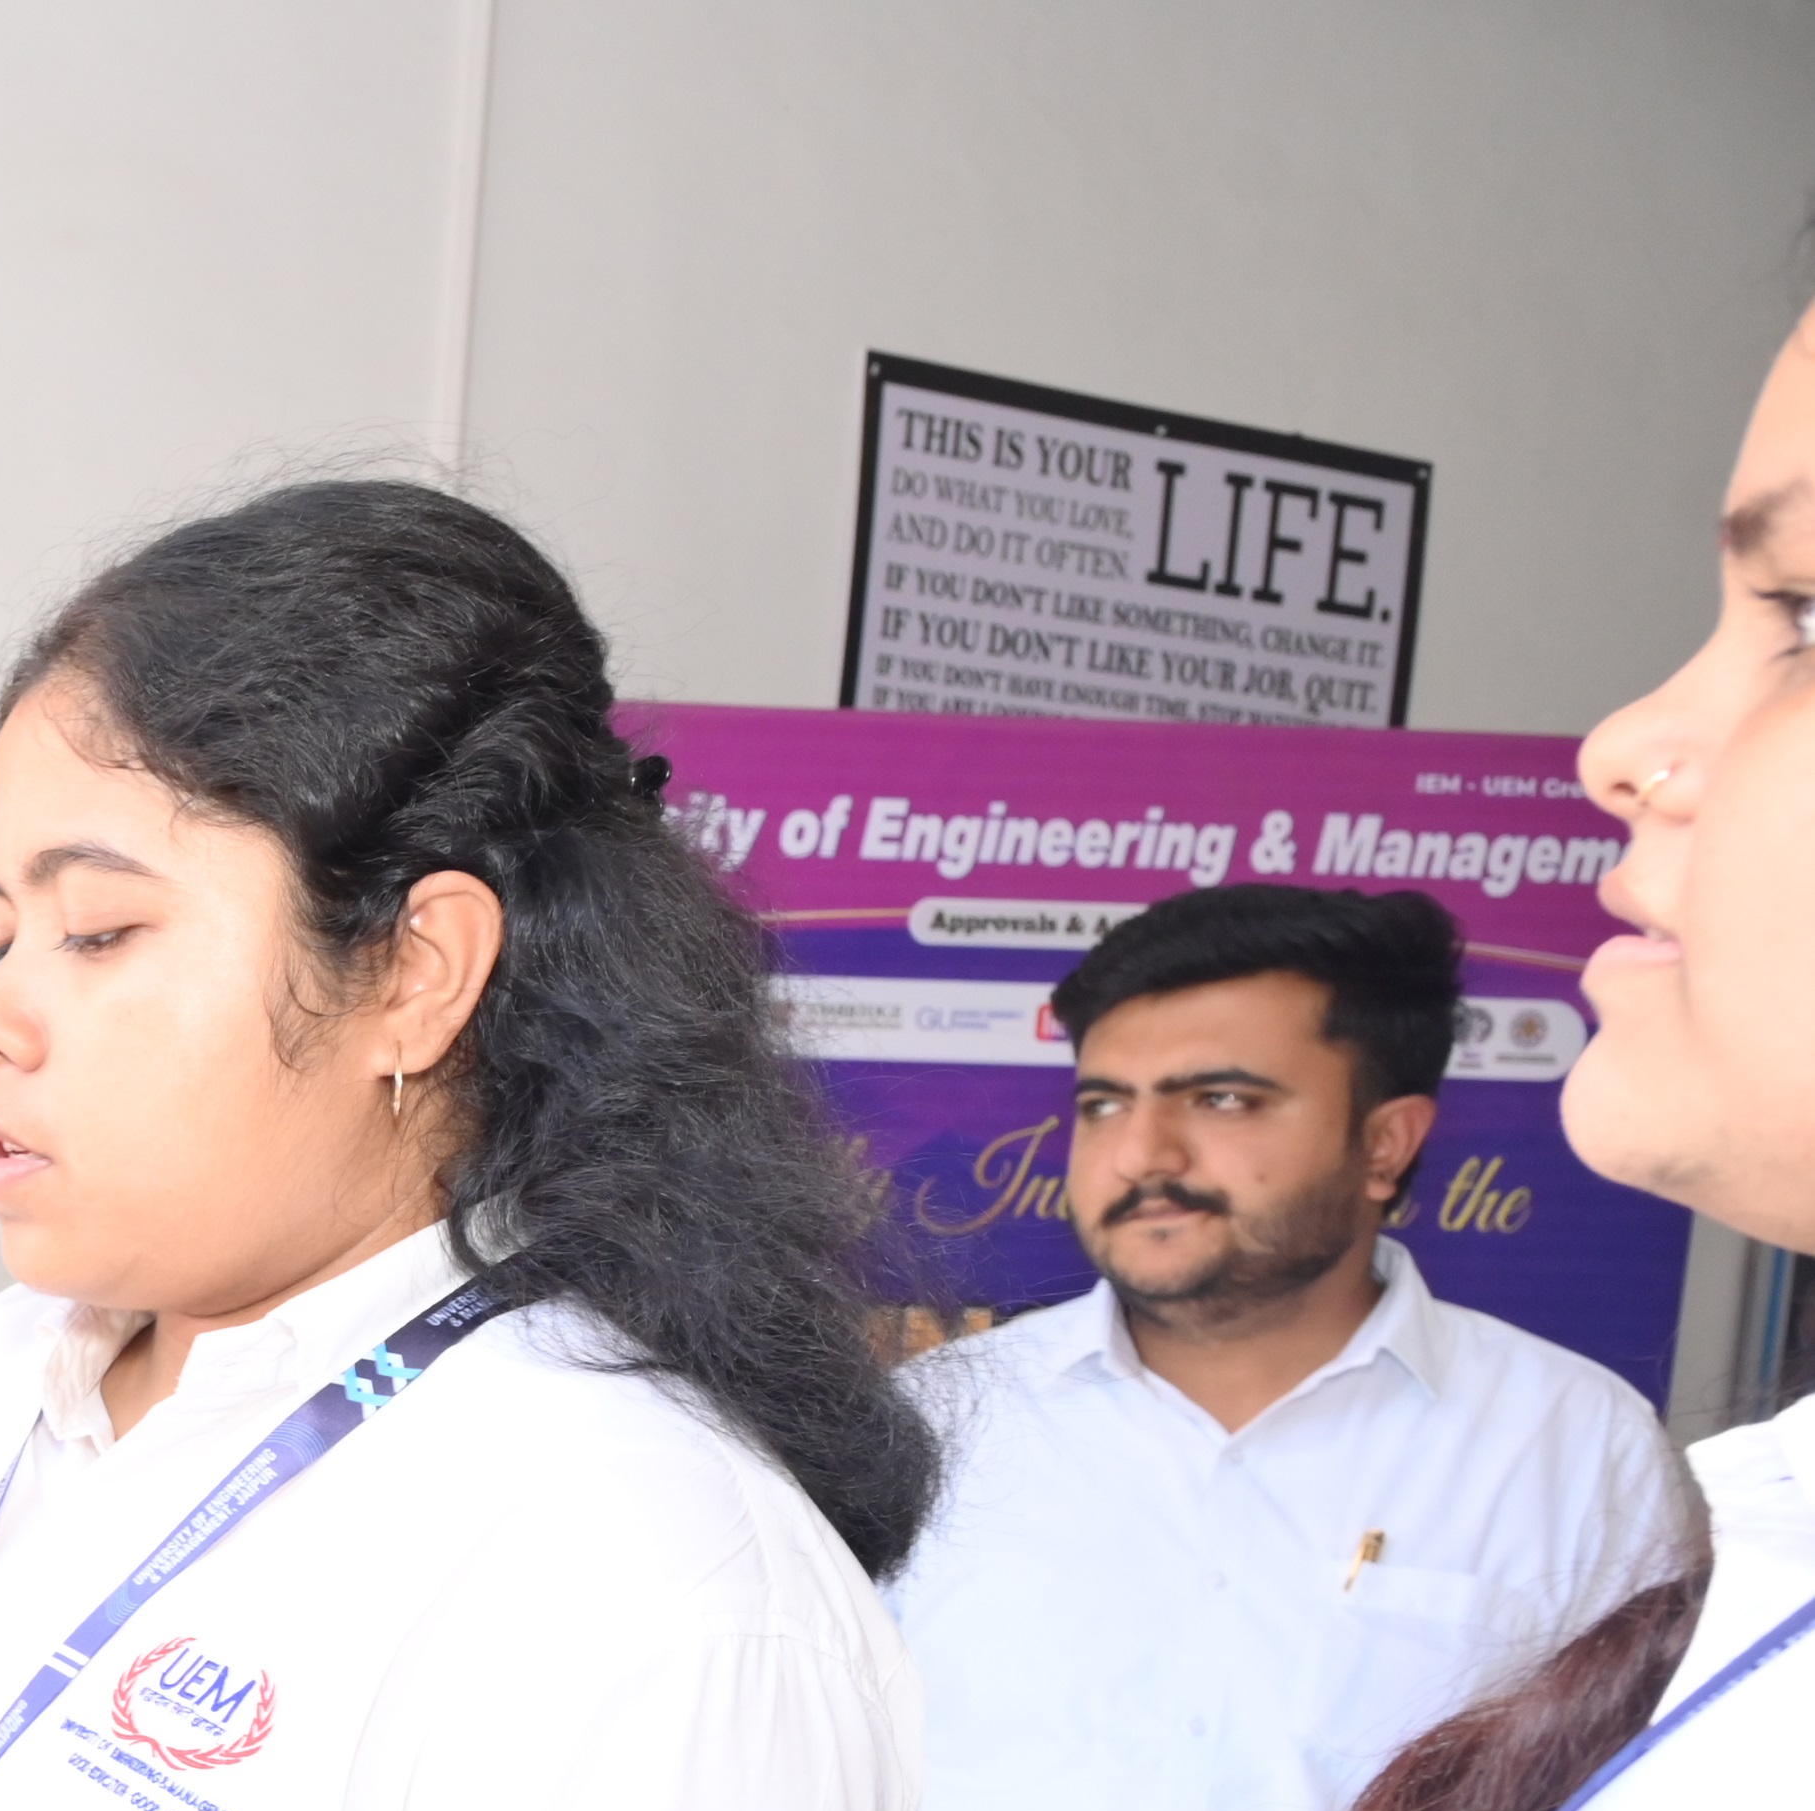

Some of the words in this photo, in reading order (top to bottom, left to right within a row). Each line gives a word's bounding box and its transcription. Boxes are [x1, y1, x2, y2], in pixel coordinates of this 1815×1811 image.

[886, 511, 950, 550] AND
[954, 520, 997, 560] DO
[999, 529, 1034, 565] IT
[890, 466, 929, 498] DO
[933, 473, 1012, 516] WHAT
[1014, 489, 1066, 526] YOU
[896, 406, 984, 464] THIS
[992, 426, 1027, 471] IS
[1035, 434, 1134, 492] YOUR
[1146, 459, 1391, 624] LIFE.
[881, 605, 912, 641] IF
[917, 609, 982, 652] YOU
[986, 621, 1083, 669] DON'T
[1086, 638, 1155, 681] LIKE
[1162, 651, 1237, 695] YOUR
[885, 560, 910, 593] IF
[915, 567, 968, 602] YOU
[1052, 590, 1105, 626] LIKE
[1259, 624, 1353, 664] CHANGE
[1414, 772, 1462, 796] IEM
[1482, 775, 1538, 799] UEM
[777, 794, 854, 860] of
[858, 795, 1238, 889] Engineering
[1248, 808, 1298, 876] &
[929, 909, 1058, 937] Approvals
[1437, 1155, 1533, 1236] the
[131, 1525, 194, 1586] UNIVERSITY
[189, 1511, 210, 1531] OF
[203, 1447, 278, 1516] ENGINEERING
[148, 1570, 163, 1585] &
[233, 1466, 279, 1506] JAIPUR
[158, 1646, 257, 1724] UEM
